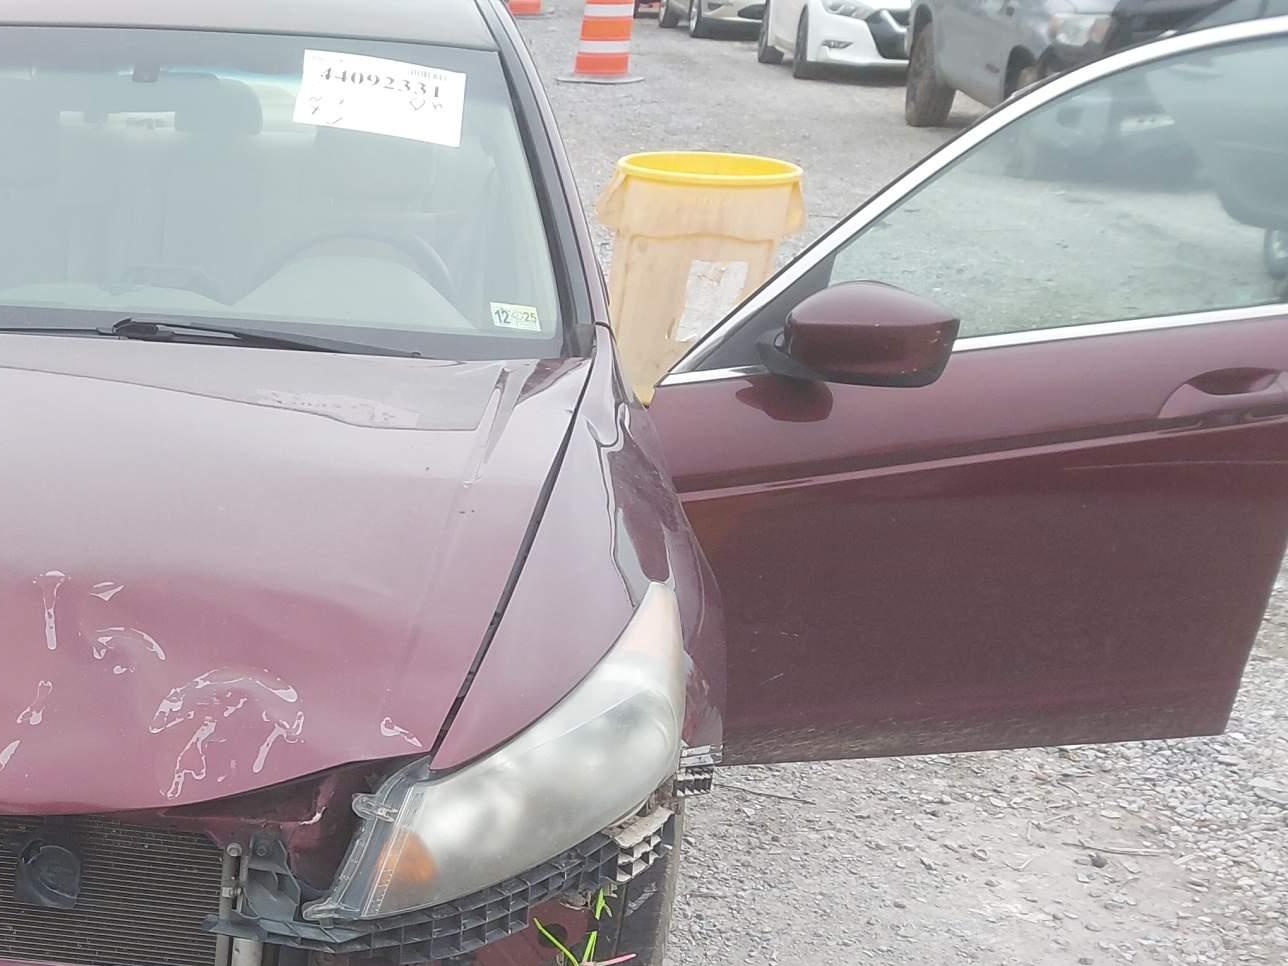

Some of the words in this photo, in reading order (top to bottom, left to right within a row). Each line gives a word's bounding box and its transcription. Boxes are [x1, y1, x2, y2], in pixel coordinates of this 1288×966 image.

[319, 66, 441, 99] 44092331
[494, 309, 512, 324] 12
[523, 311, 537, 322] 25
